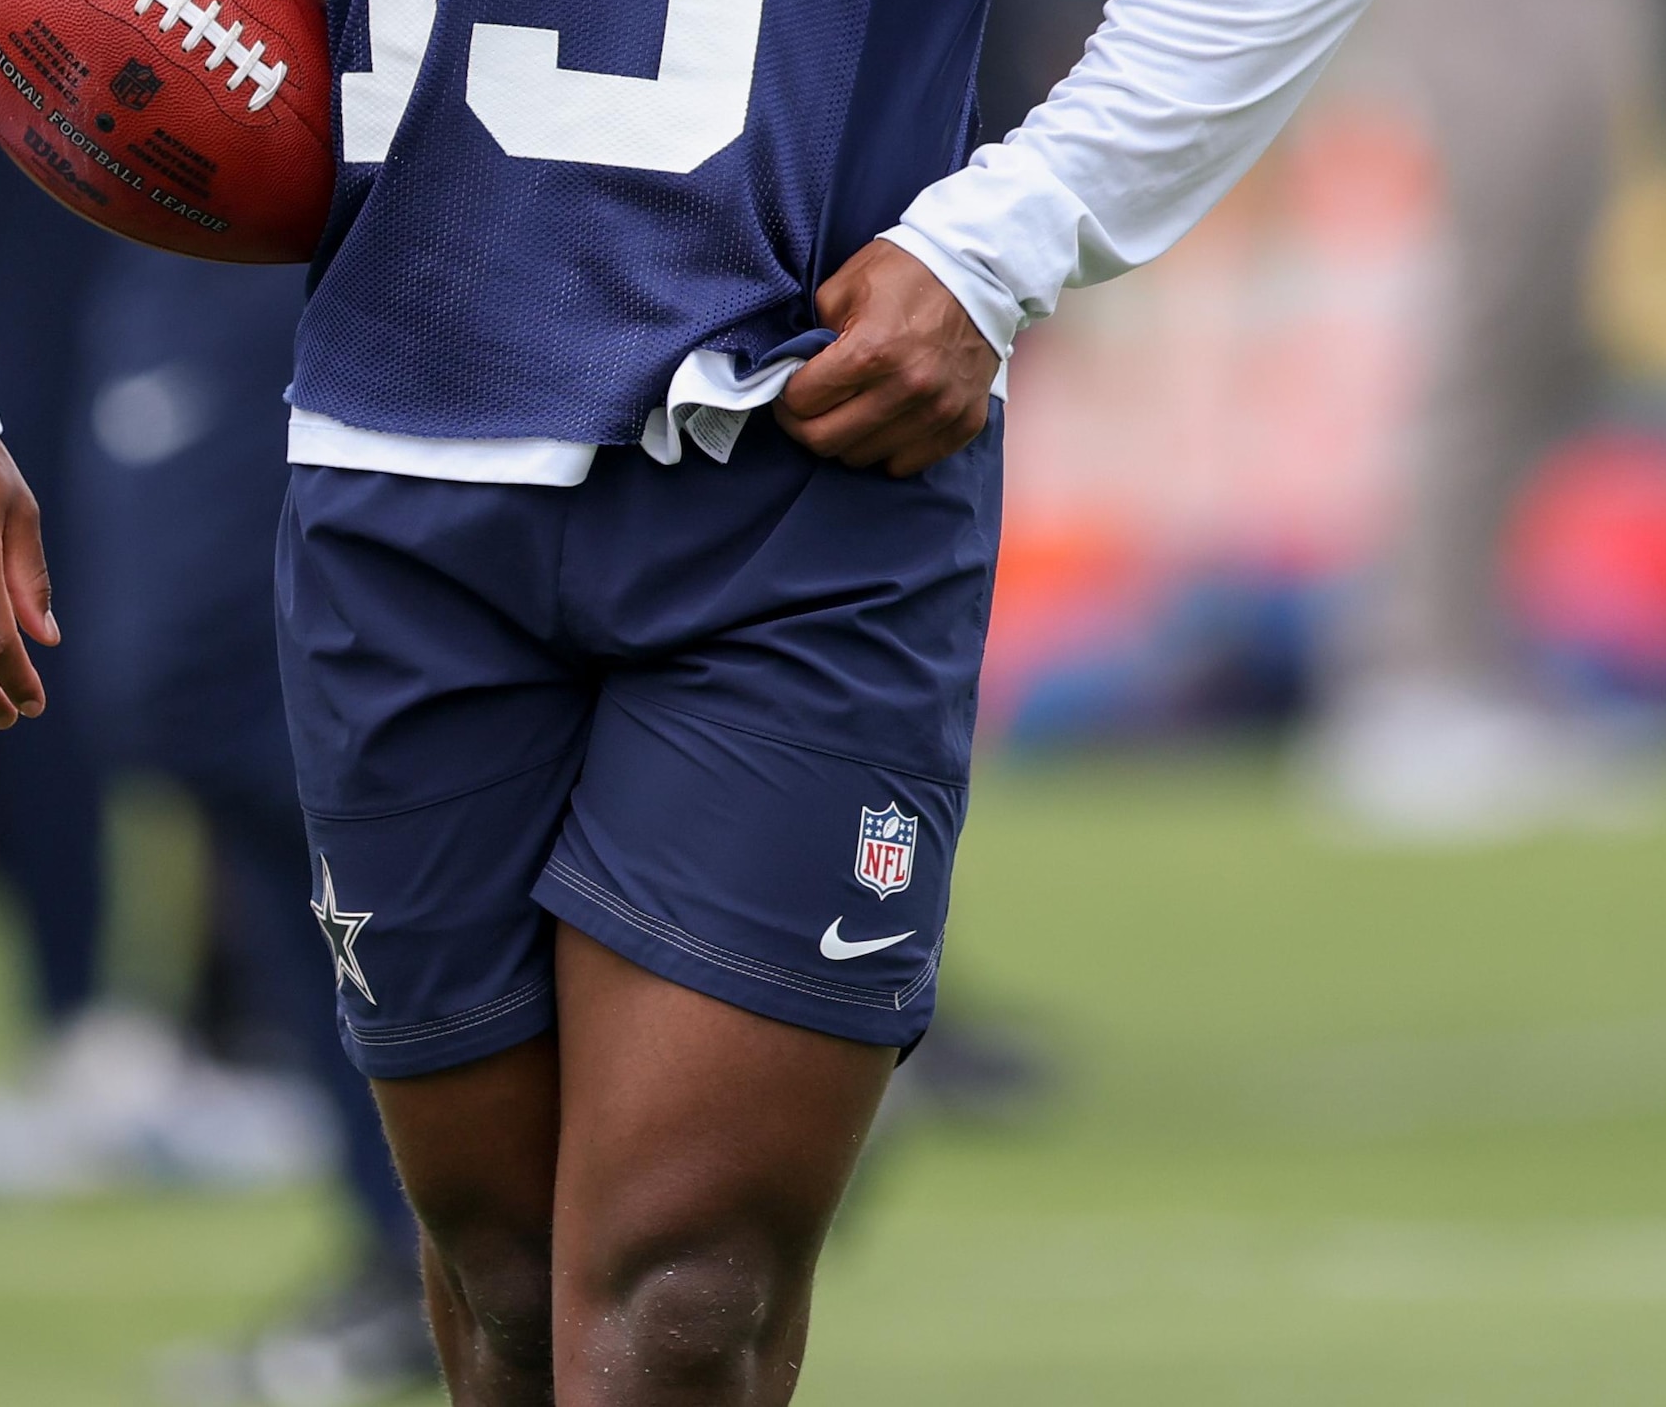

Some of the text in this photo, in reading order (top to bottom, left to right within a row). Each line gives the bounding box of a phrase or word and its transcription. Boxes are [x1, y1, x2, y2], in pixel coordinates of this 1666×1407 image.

[9, 32, 79, 105] CONFERENCE
[25, 28, 79, 88] FOOTBALL
[33, 19, 90, 77] AMERICAN
[48, 110, 143, 191] FOOTBALL
[149, 188, 229, 233] LEAGUE
[863, 841, 906, 885] NFL
